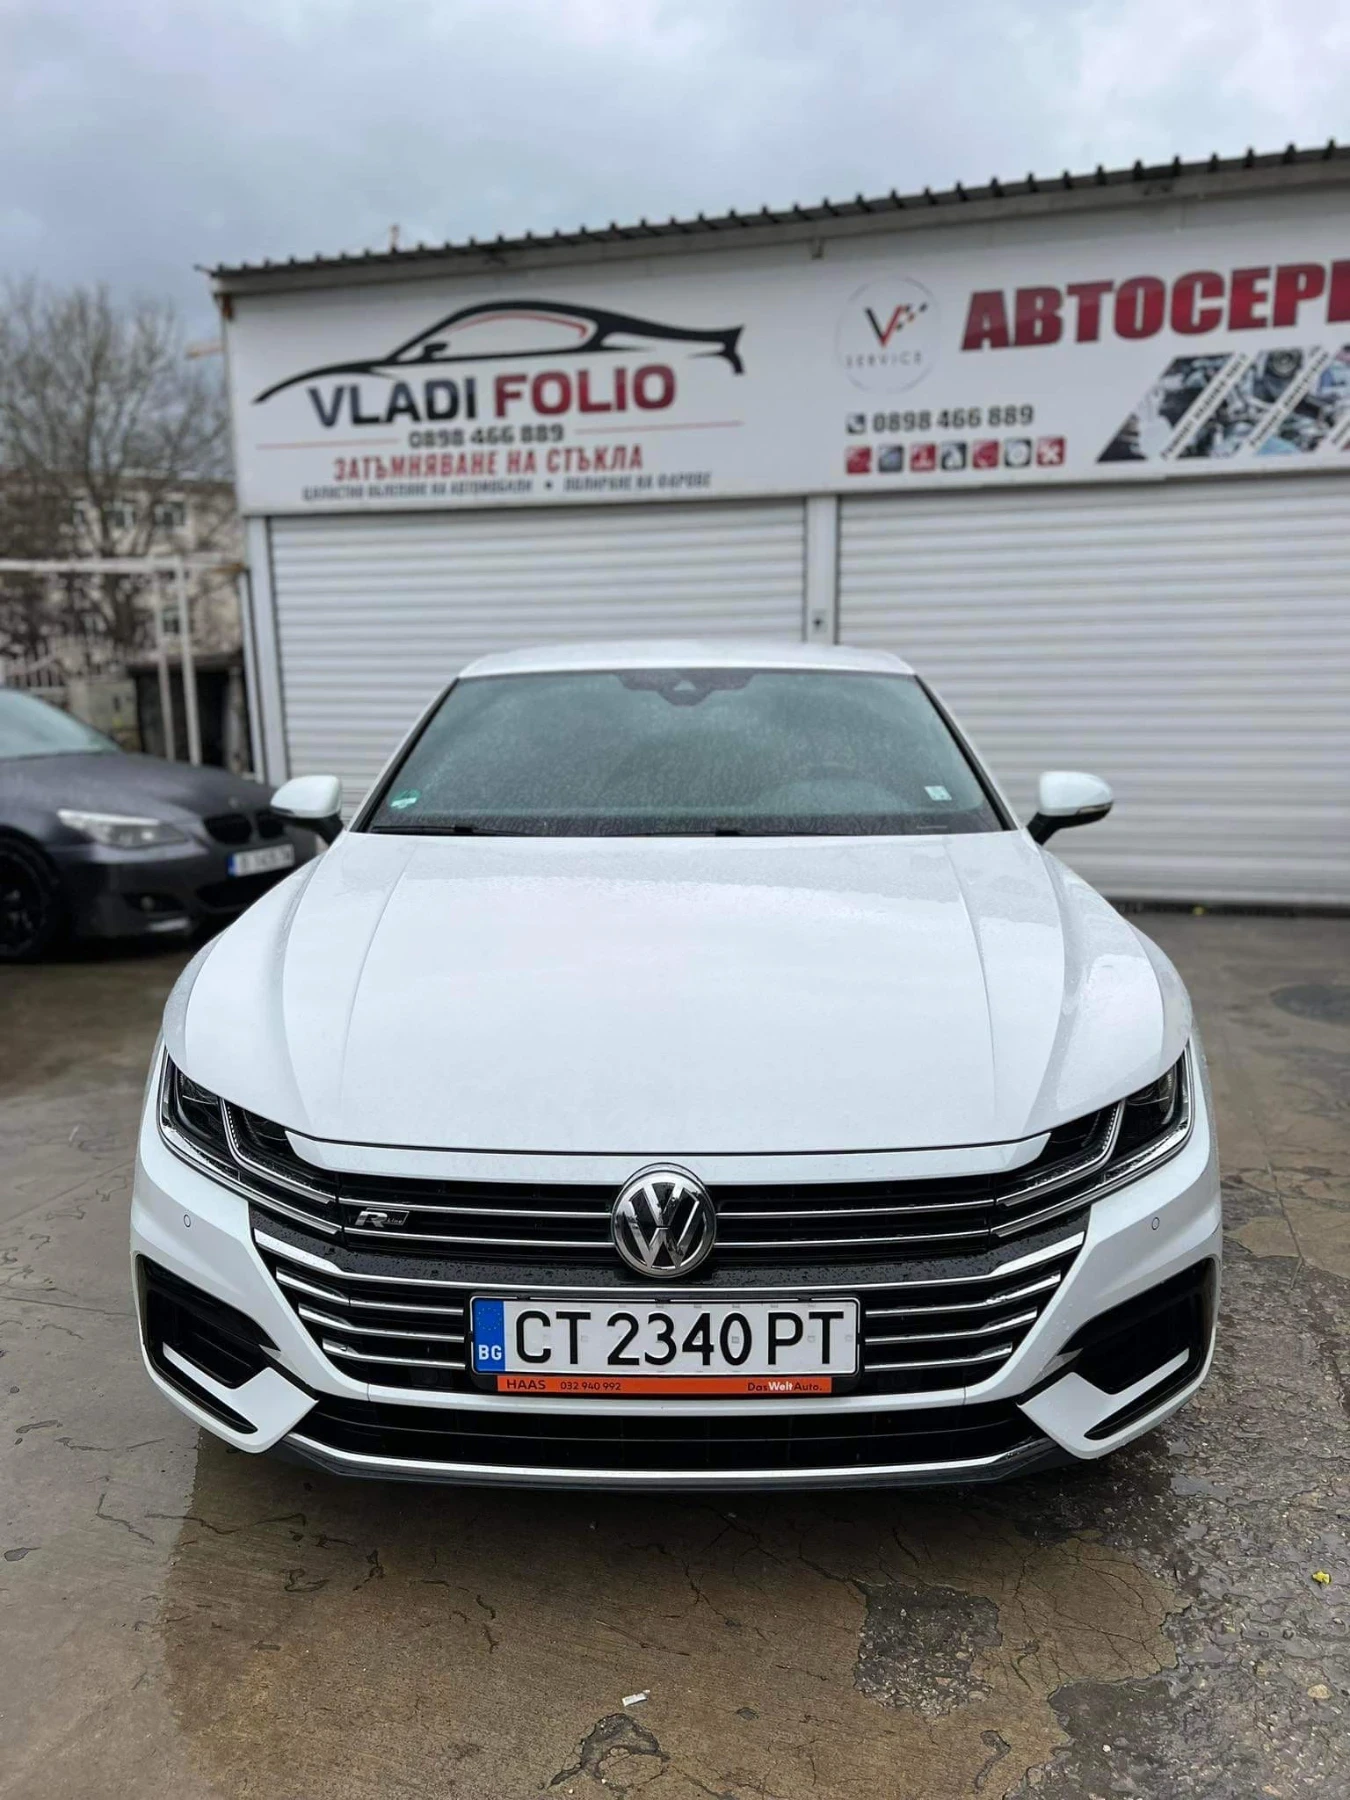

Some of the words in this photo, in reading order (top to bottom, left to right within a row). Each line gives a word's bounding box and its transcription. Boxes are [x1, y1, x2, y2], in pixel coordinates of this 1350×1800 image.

[307, 377, 477, 428] VLADI
[494, 363, 676, 419] FOLIO
[873, 411, 931, 432] 0898
[937, 406, 981, 428] 466
[987, 404, 1034, 427] 889
[409, 430, 465, 450] 0898
[470, 426, 515, 446] 466
[520, 424, 564, 444] 889
[334, 450, 496, 481] ЗАТЪМНЯВАНЕ
[507, 448, 536, 473] НА
[546, 443, 643, 473] СТЪКЛА
[516, 1310, 591, 1364] CT
[607, 1311, 752, 1366] 2340
[767, 1311, 844, 1365] PT
[478, 1345, 502, 1361] BG
[506, 1379, 546, 1390] HAAS
[560, 1382, 579, 1391] 032
[582, 1382, 600, 1391] 940
[602, 1382, 621, 1391] 992
